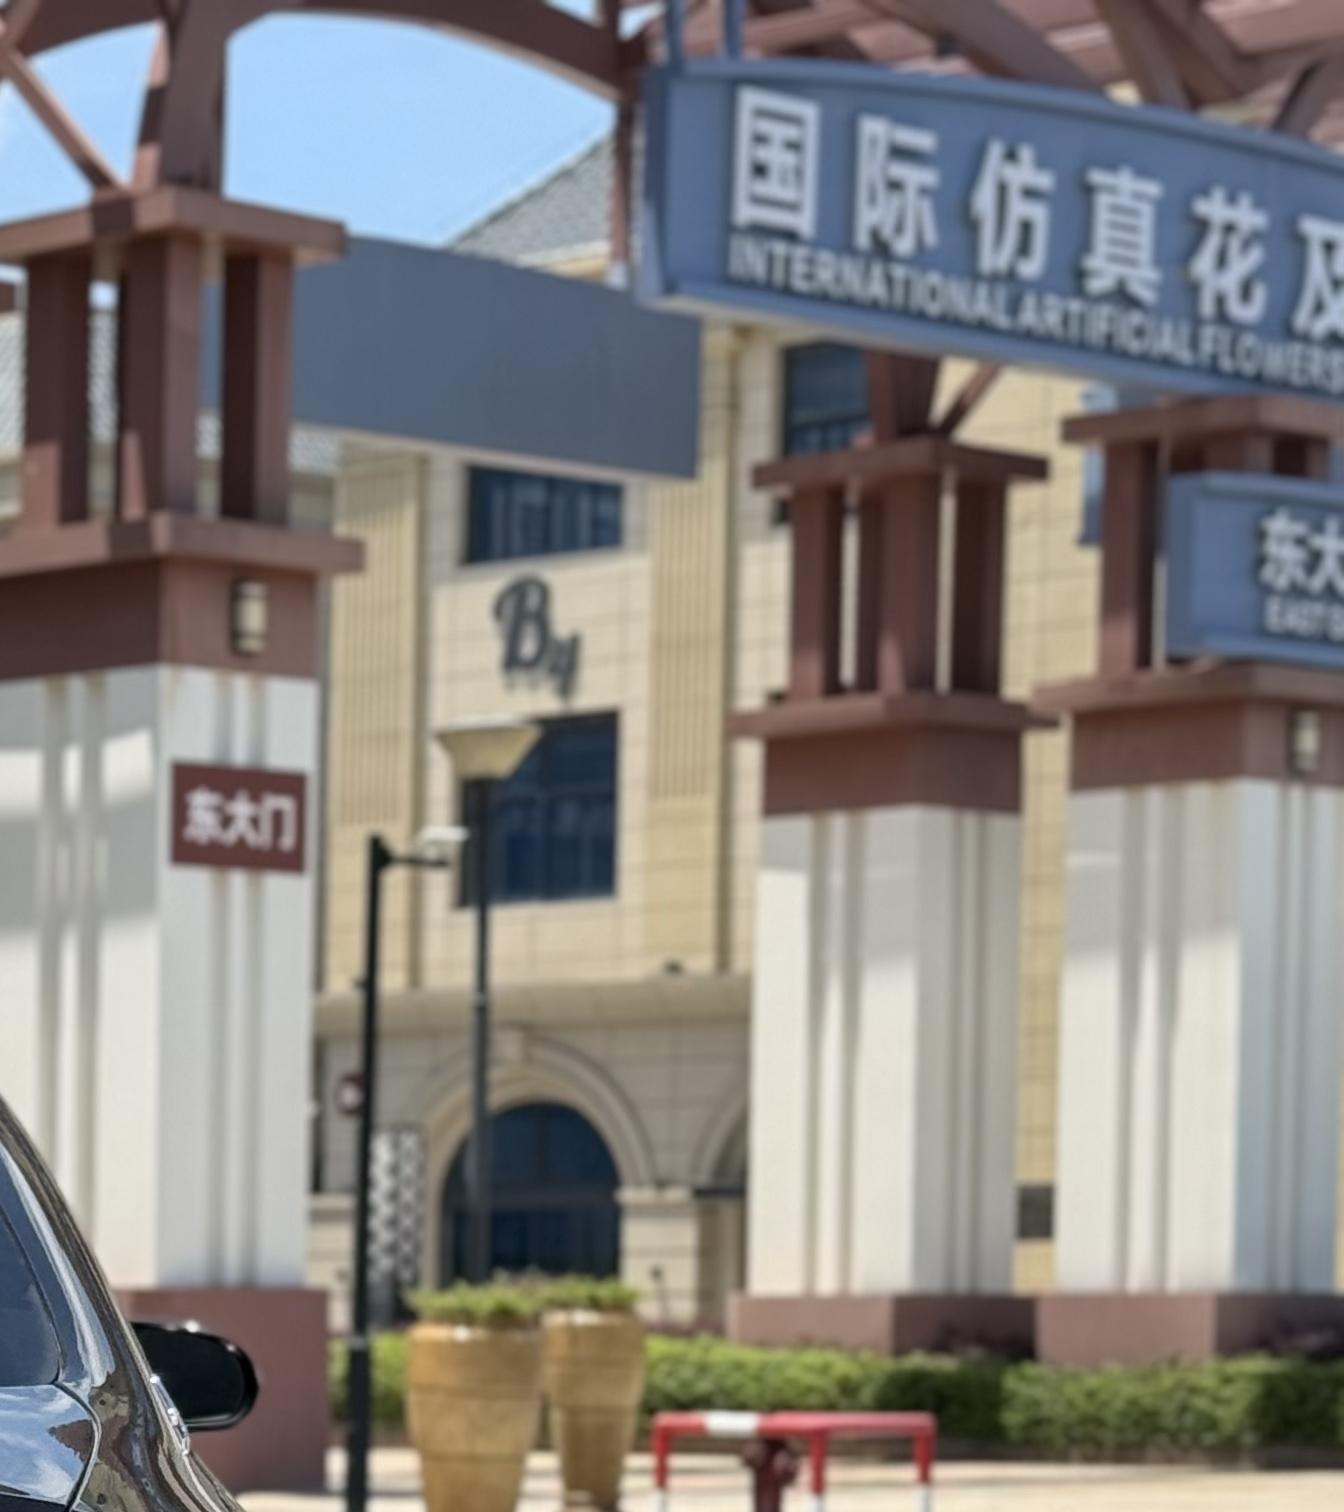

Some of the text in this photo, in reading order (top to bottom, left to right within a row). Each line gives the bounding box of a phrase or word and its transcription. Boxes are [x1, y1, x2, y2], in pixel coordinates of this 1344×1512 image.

[729, 233, 1012, 333] INTERNATIONAL
[1015, 289, 1192, 366] ARTIFICIAL
[182, 785, 296, 852] 东大门
